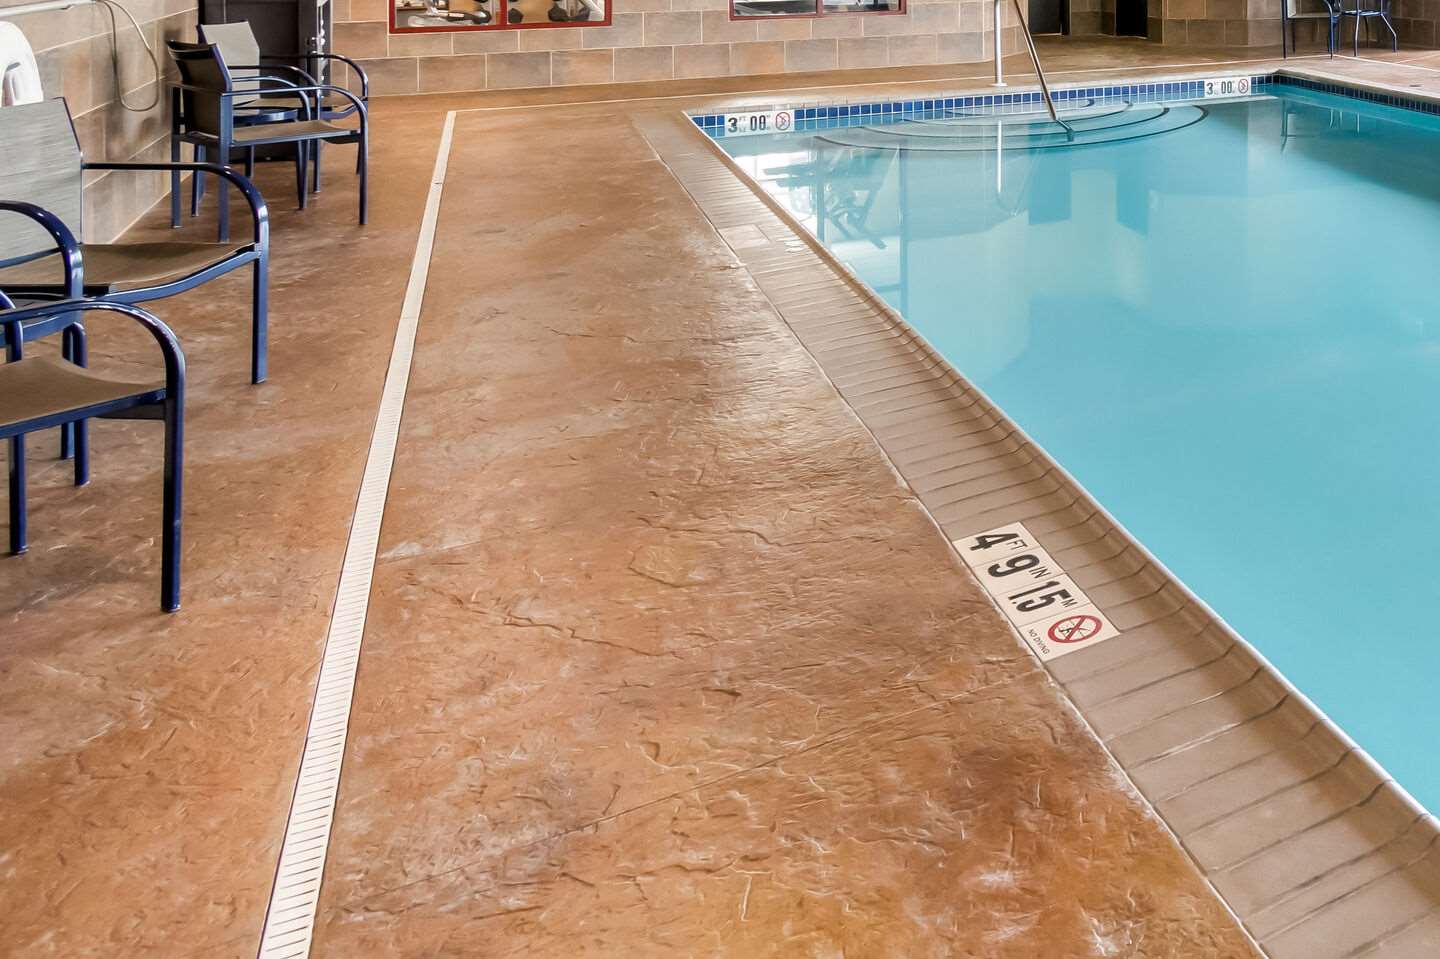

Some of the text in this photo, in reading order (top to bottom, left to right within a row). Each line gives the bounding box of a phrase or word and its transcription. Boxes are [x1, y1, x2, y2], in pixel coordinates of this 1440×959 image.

[727, 117, 738, 133] 3
[970, 533, 1019, 552] 4
[1009, 539, 1029, 551] FT
[987, 554, 1040, 578] 9
[1028, 566, 1052, 579] IN
[1062, 597, 1078, 608] M
[1029, 629, 1038, 637] NO
